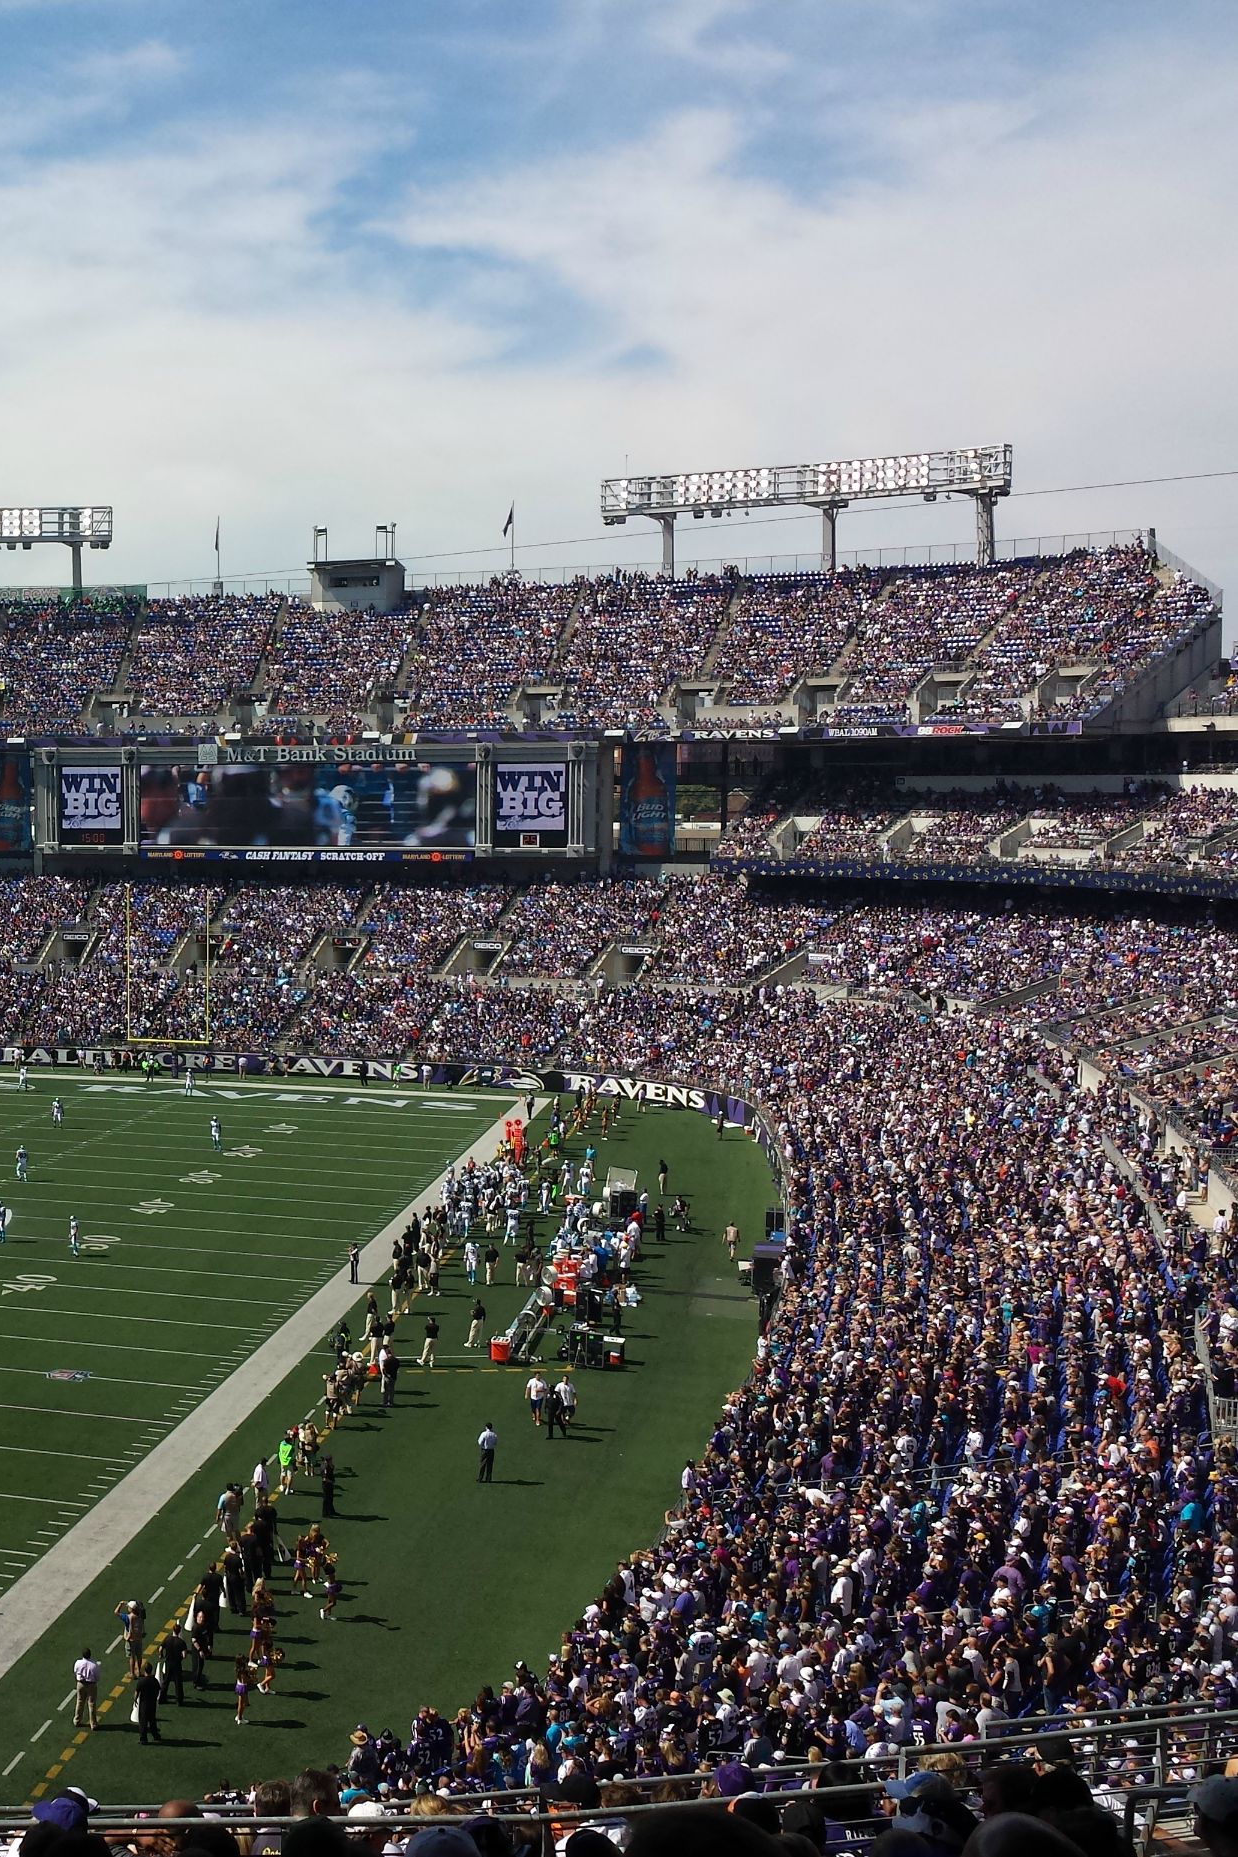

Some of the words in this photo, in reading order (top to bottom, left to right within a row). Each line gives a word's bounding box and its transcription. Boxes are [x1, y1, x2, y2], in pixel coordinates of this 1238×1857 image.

[691, 729, 774, 740] RAVENS
[828, 728, 849, 737] WBAL
[931, 726, 963, 735] ROCK
[226, 747, 269, 762] M&T
[276, 746, 326, 762] Bank
[334, 746, 417, 762] Stadium
[62, 774, 119, 793] WIN
[497, 771, 563, 792] WIN
[64, 793, 120, 815] BIG
[499, 791, 563, 816] BIG
[636, 803, 664, 812] BUD
[632, 810, 667, 821] LIGHT
[244, 851, 269, 861] CASH
[270, 851, 313, 861] FANTASY
[319, 852, 385, 861] SCRATCH-OFF
[260, 1056, 417, 1079] AVENS
[77, 1083, 479, 1111] RAVENS
[562, 1074, 706, 1109] RAVENS
[179, 1172, 223, 1184] 30
[130, 1201, 175, 1215] 40
[3, 1274, 58, 1293] 40
[429, 1728, 445, 1742] 52
[912, 1731, 926, 1746] 55
[417, 1749, 431, 1765] 52
